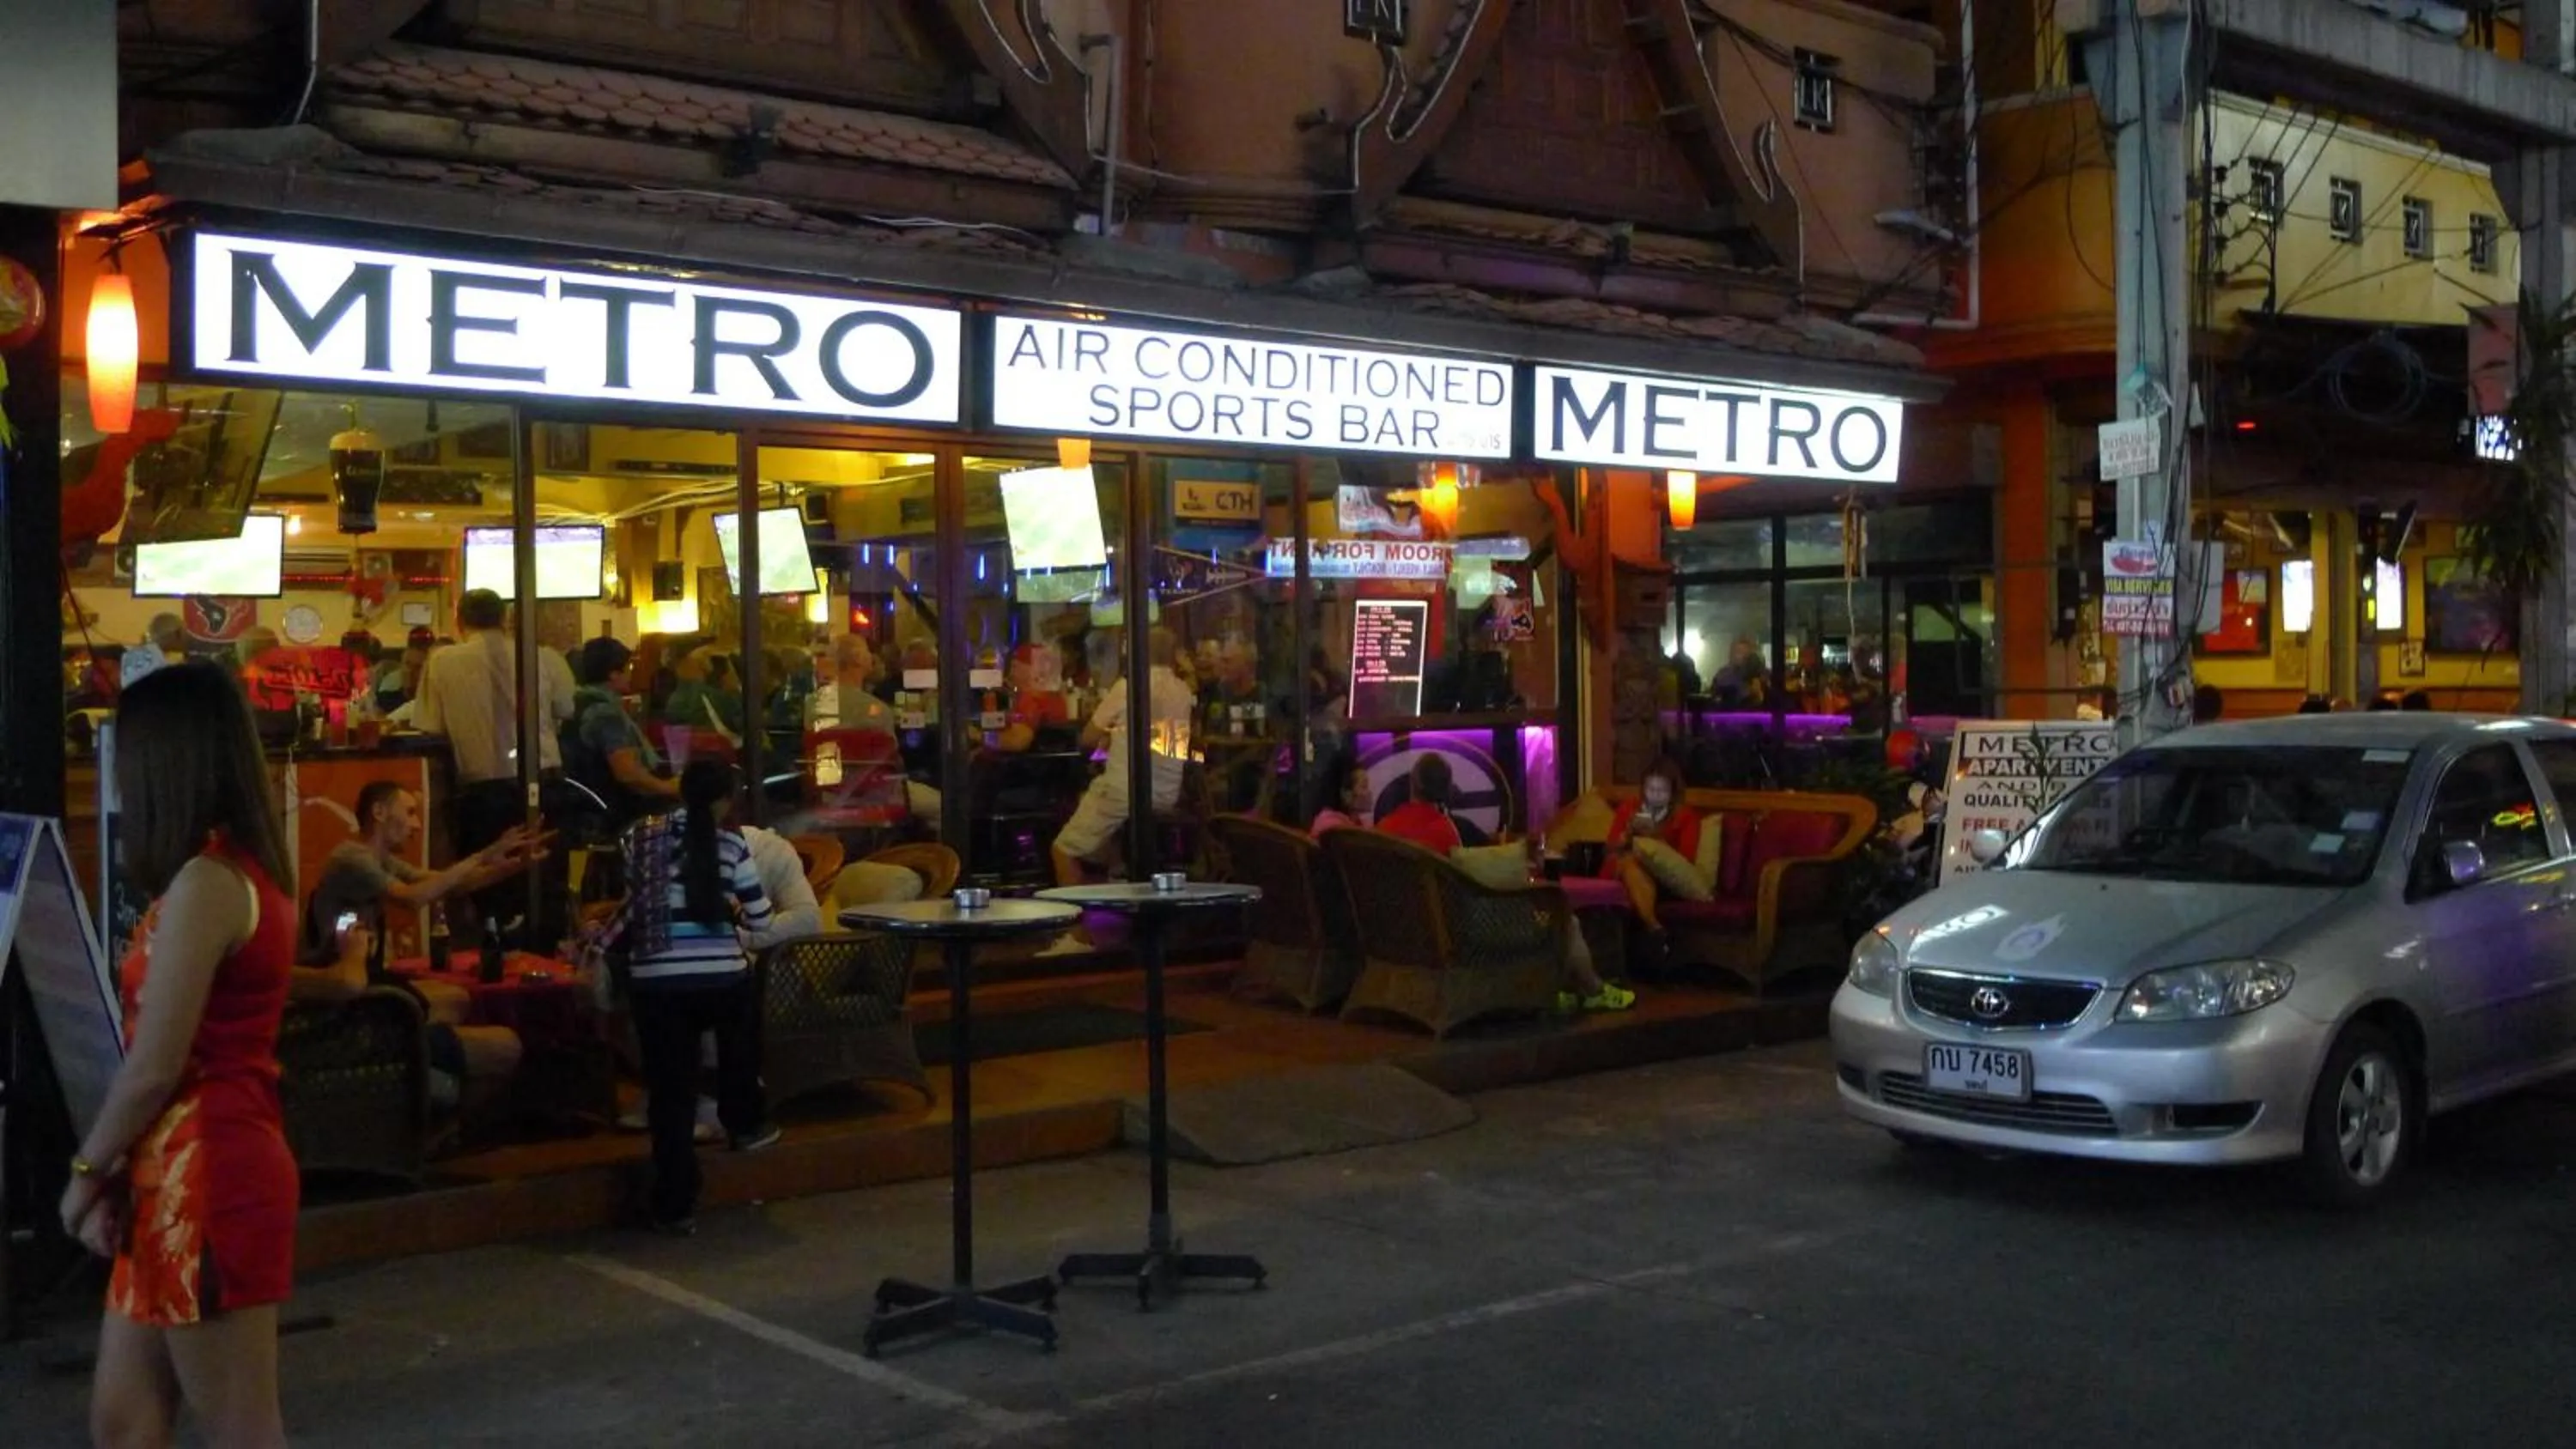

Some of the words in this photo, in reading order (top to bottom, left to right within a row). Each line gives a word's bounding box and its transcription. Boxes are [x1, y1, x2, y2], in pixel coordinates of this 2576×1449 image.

[225, 249, 935, 408] METRO
[1007, 324, 1109, 373] AIR
[1134, 336, 1505, 407] CONDITIONED
[1088, 383, 1313, 441] SPORTS
[1340, 403, 1440, 449] BAR
[1551, 375, 1887, 474] METRO
[1978, 780, 2037, 791] AND
[1962, 817, 2009, 831] FREE
[1969, 1049, 2020, 1078] 7458
